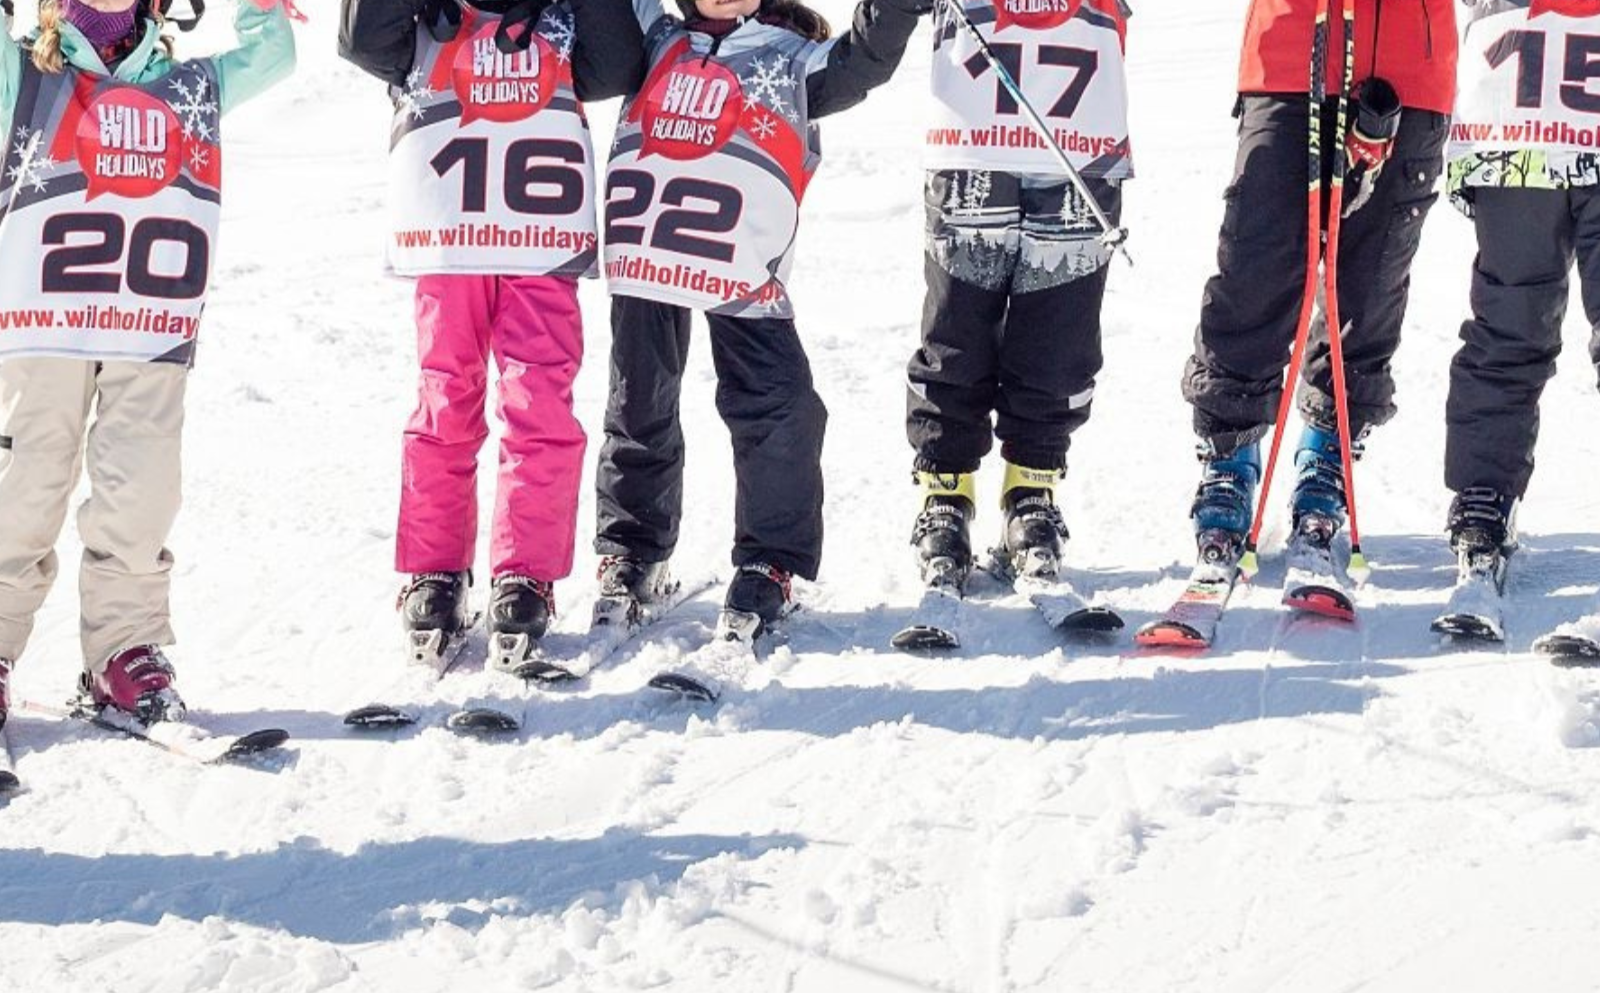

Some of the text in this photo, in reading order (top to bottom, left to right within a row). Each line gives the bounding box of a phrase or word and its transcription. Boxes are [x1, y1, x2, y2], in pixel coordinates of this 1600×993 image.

[469, 79, 540, 105] HOLIDAYS
[661, 71, 730, 121] WILD
[963, 42, 1099, 120] 17
[98, 103, 168, 152] WILD
[649, 116, 717, 146] HOLIDAYS
[1308, 101, 1321, 155] LEKI
[1335, 96, 1348, 150] LEKI
[96, 153, 167, 180] HOLIDAYS
[429, 137, 586, 216] 16
[604, 168, 744, 264] 22
[42, 211, 209, 300] 20
